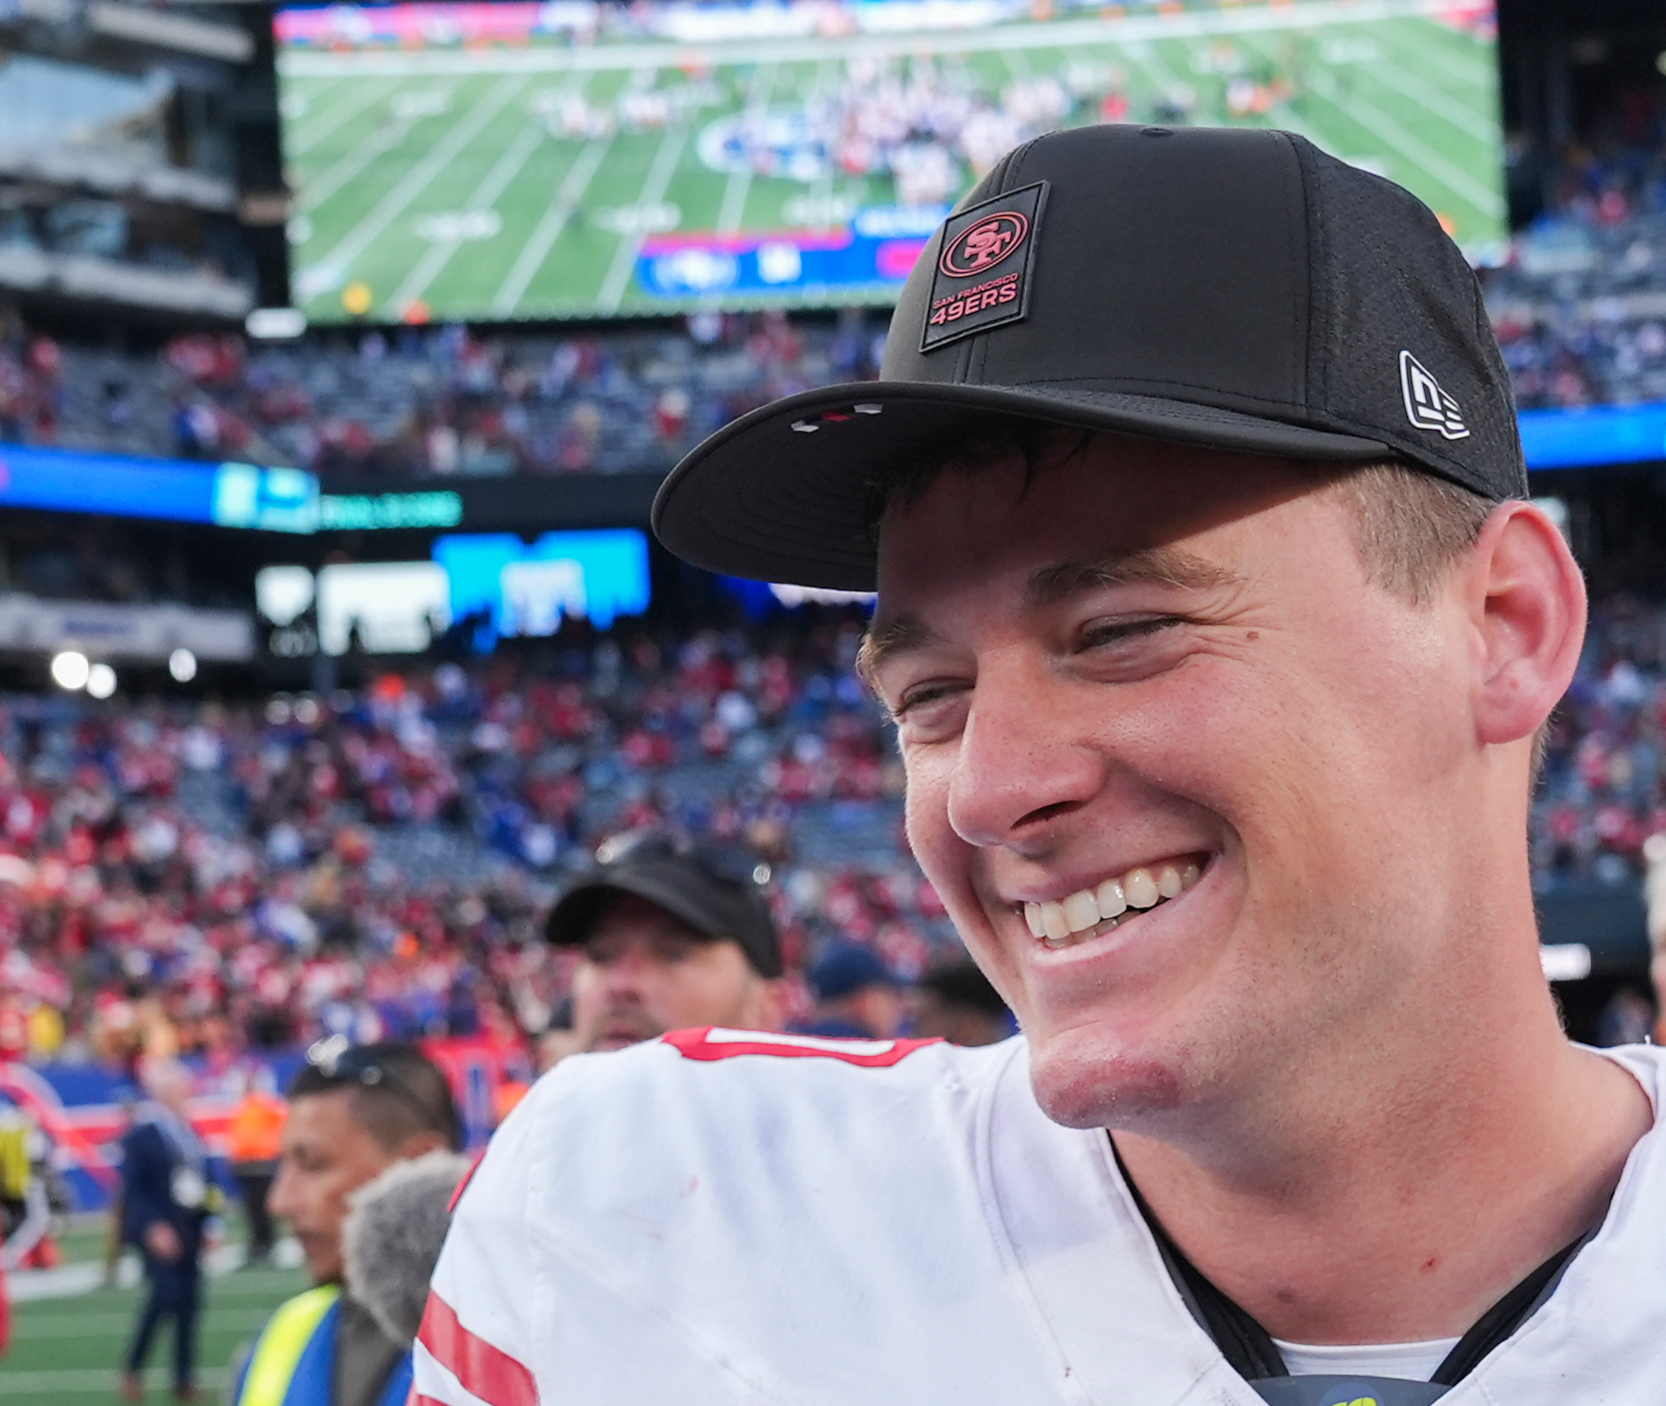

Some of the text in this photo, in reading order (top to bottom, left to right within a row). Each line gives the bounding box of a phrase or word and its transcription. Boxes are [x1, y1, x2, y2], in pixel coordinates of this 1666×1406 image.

[929, 282, 1018, 325] 49ERS
[934, 272, 1020, 309] SAN FRANCISCO
